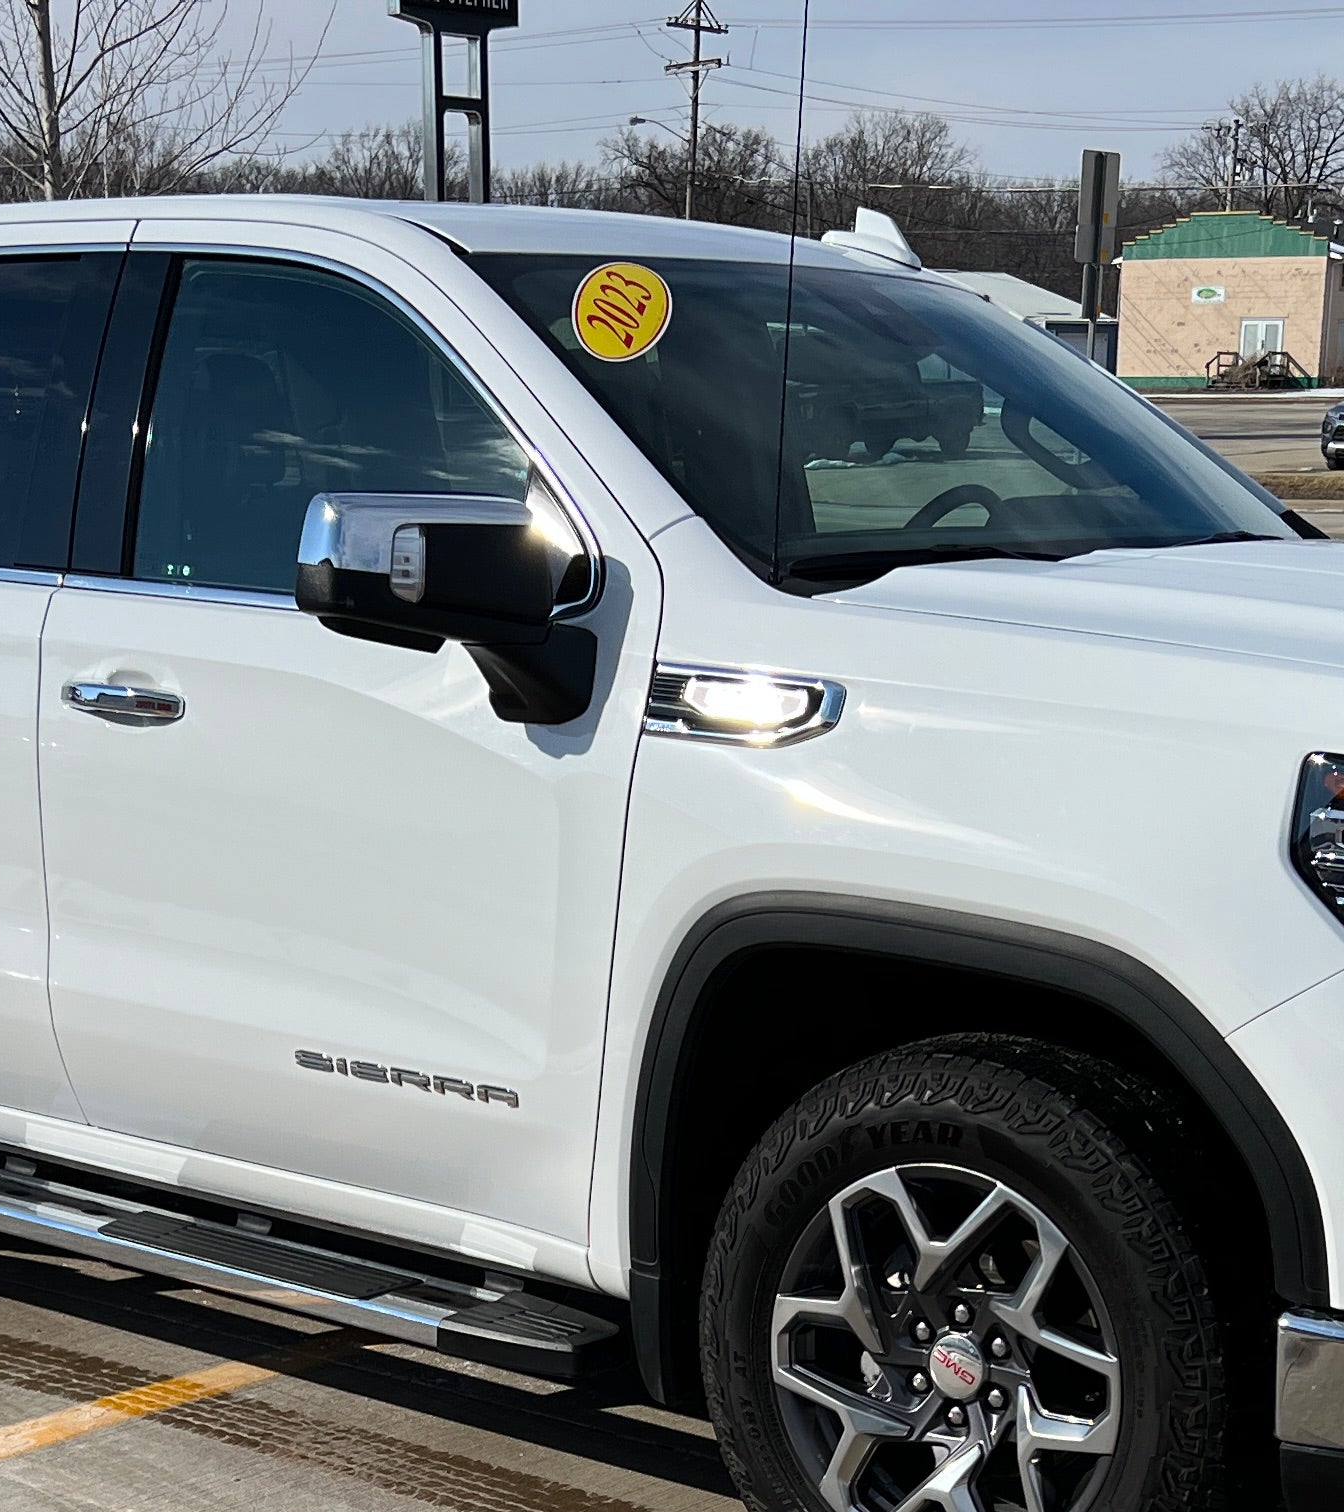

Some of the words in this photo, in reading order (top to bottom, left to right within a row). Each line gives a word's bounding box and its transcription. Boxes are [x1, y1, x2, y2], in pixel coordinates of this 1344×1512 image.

[586, 271, 652, 349] 2023
[293, 1049, 519, 1108] SIERRA
[762, 1119, 962, 1229] GOODYEAR
[933, 1348, 975, 1385] GMC
